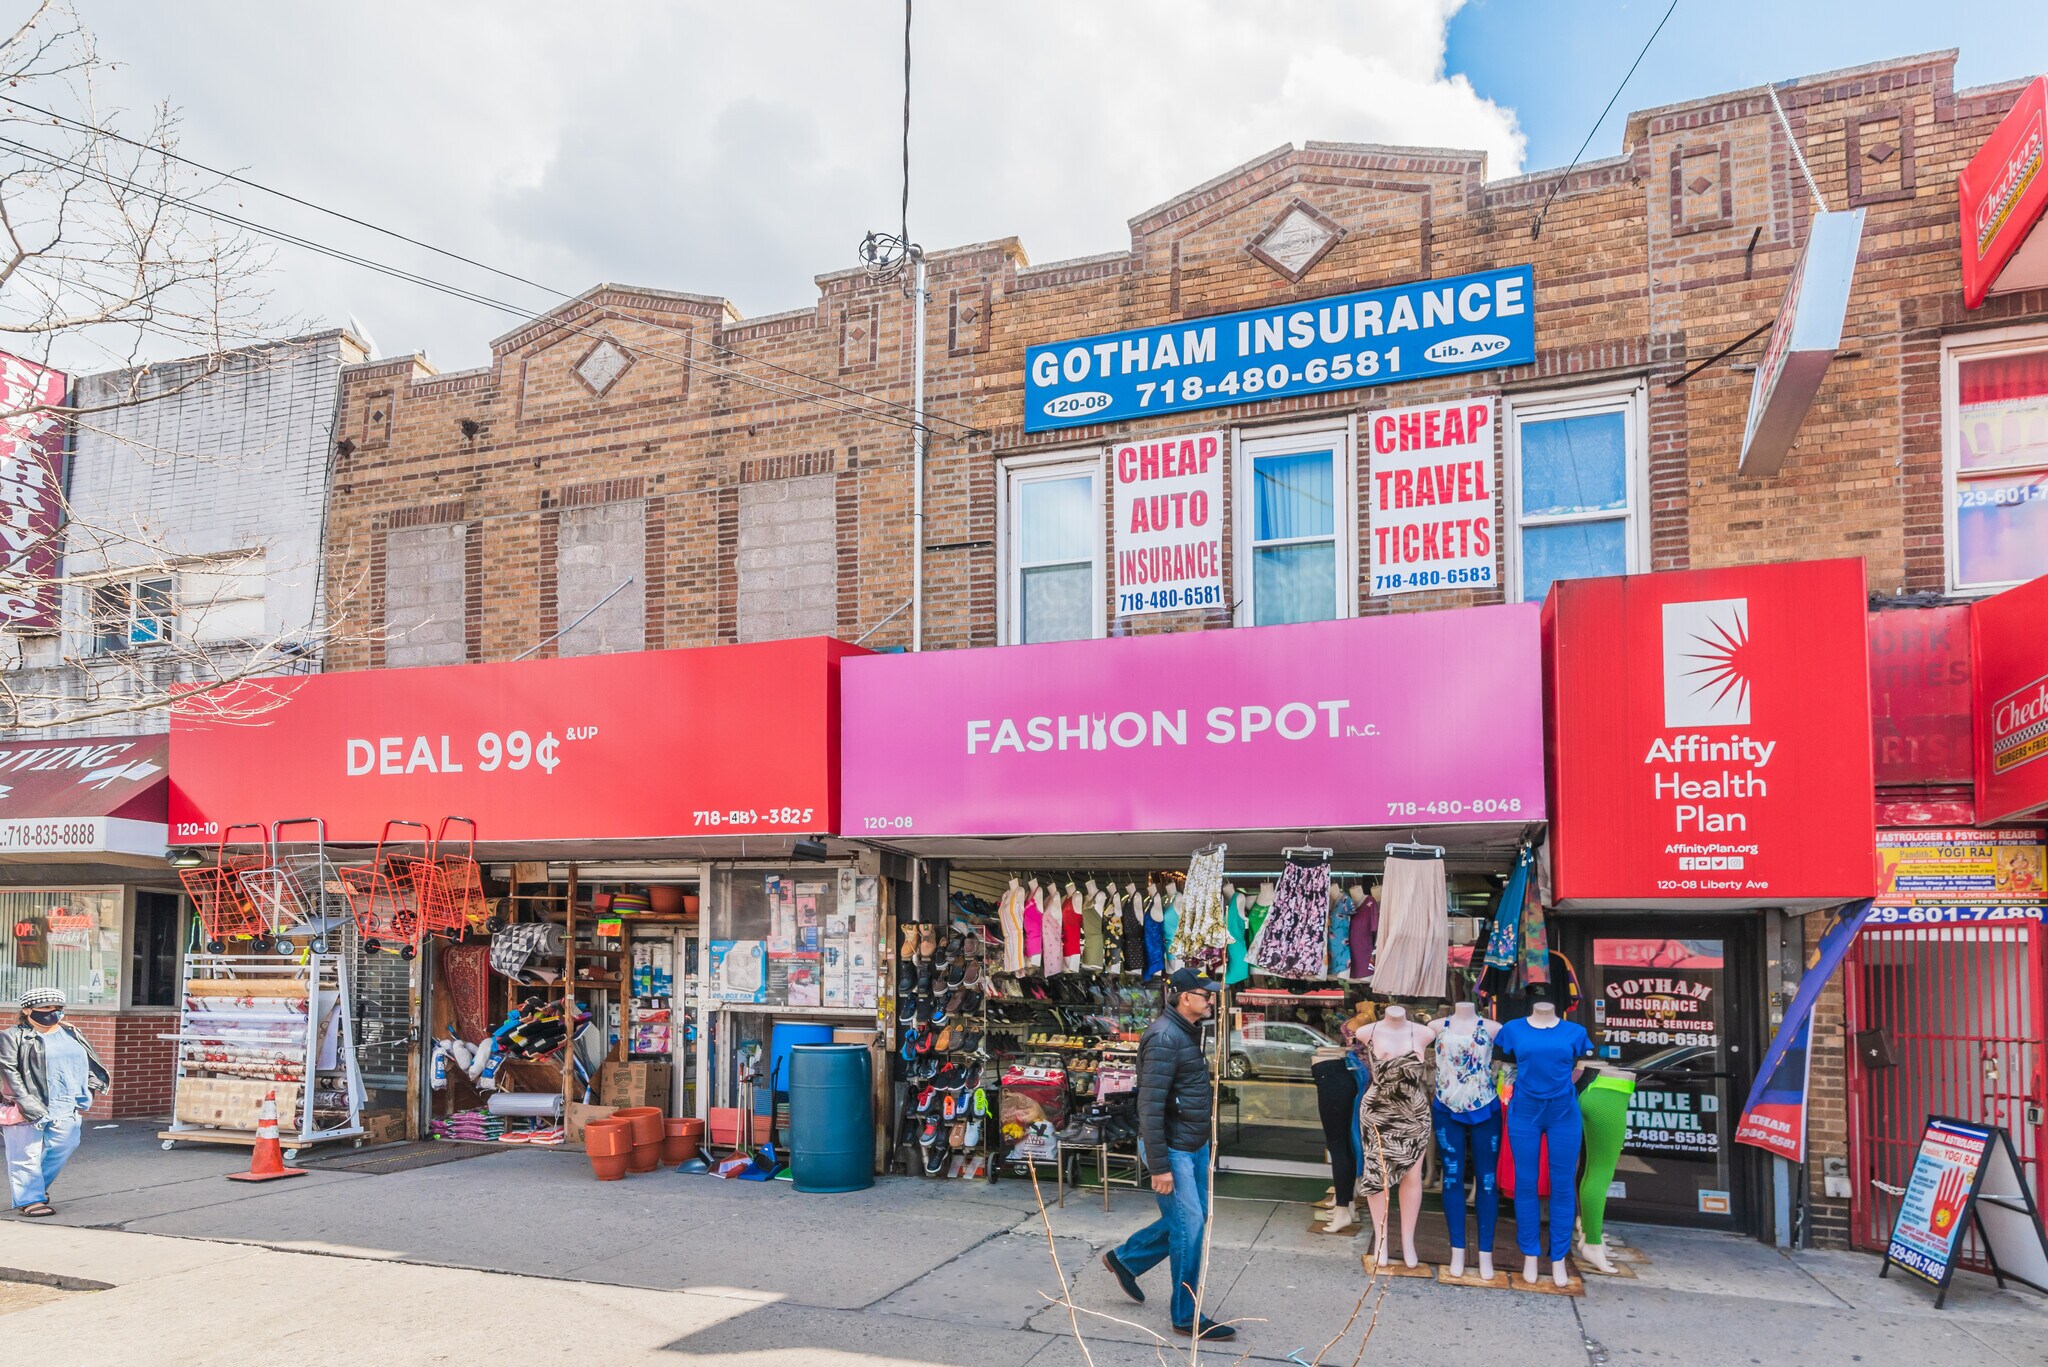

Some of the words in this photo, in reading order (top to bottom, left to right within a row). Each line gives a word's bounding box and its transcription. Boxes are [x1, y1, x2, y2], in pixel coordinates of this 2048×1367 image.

[1979, 127, 2038, 229] Checkers
[1032, 327, 1216, 388] GOTHAM
[1238, 276, 1524, 357] INSURANCE
[1431, 346, 1464, 359] Lib.
[1471, 340, 1505, 353] Ave
[1136, 346, 1400, 408] 718-480-6581
[1048, 395, 1107, 414] 120-08
[1374, 404, 1488, 454] CHEAP
[1118, 437, 1217, 484] CHEAP
[1375, 460, 1489, 510] TRAVEL
[1130, 490, 1208, 534] AUTO
[1375, 517, 1490, 564] TICKETS
[1119, 541, 1218, 587] INSURANCE
[1376, 566, 1491, 589] 718-480-6583
[1120, 585, 1220, 611] 718-480-6581
[967, 710, 1187, 754] FASHION
[1206, 700, 1349, 743] SPOT
[347, 736, 463, 776] DEAL
[477, 730, 561, 775] 99¢
[566, 725, 598, 741] &UP
[1644, 735, 1776, 767] Affinity
[1654, 770, 1767, 799] Health
[1387, 798, 1521, 816] 718-480-8048
[177, 821, 218, 836] 120-10
[863, 816, 913, 829] 120-08
[1676, 804, 1746, 833] Plan
[1882, 832, 1941, 842] ASTROLOGER
[1946, 832, 1952, 840] &
[1955, 831, 1996, 840] PSYCHIC
[1999, 831, 2037, 839] READER
[1665, 844, 1758, 855] AffinityPlan.org
[1938, 848, 1965, 858] YOGI
[1970, 847, 1993, 858] RAJ
[1657, 880, 1697, 889] 120-08
[1700, 880, 1742, 890] Liberty
[1746, 880, 1768, 889] Ave
[15, 922, 42, 937] OPEN
[92, 973, 100, 986] A
[1605, 979, 1712, 1001] GOTHAM
[1620, 998, 1698, 1012] INSURANCE
[1605, 1018, 1659, 1028] FINANCIAL
[1663, 1019, 1714, 1030] SERVICES
[1603, 1029, 1718, 1047] 718-480-6581
[1701, 1094, 1718, 1112] D
[1626, 1110, 1701, 1130] TRAVEL
[1642, 1142, 1674, 1150] Anywhere
[1945, 1149, 1961, 1162] YOGI
[1964, 1153, 1981, 1168] RAJ
[1889, 1242, 1946, 1280] 929-601-7489
